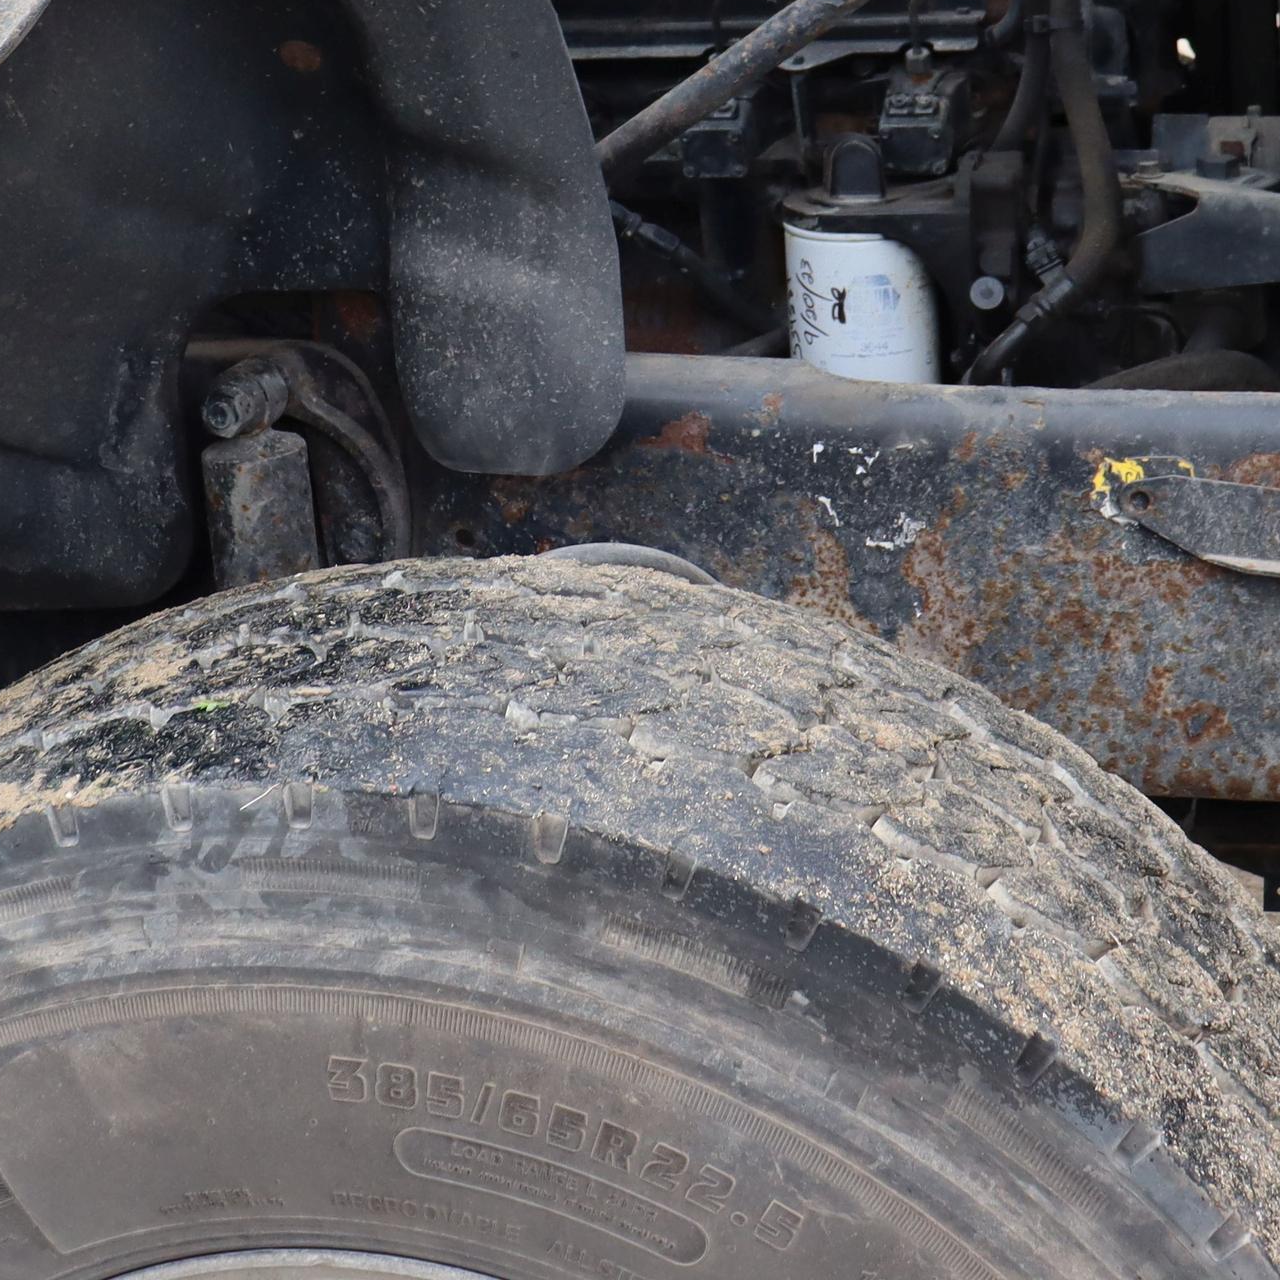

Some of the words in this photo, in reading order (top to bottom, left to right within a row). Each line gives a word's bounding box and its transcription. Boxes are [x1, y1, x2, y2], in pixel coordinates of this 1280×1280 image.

[795, 258, 834, 345] 9/20/23
[327, 1055, 805, 1251] 385/65R22.5
[451, 1140, 504, 1166] LOAD
[513, 1158, 578, 1192] RANGE
[330, 1189, 528, 1245] REGROOVABLE
